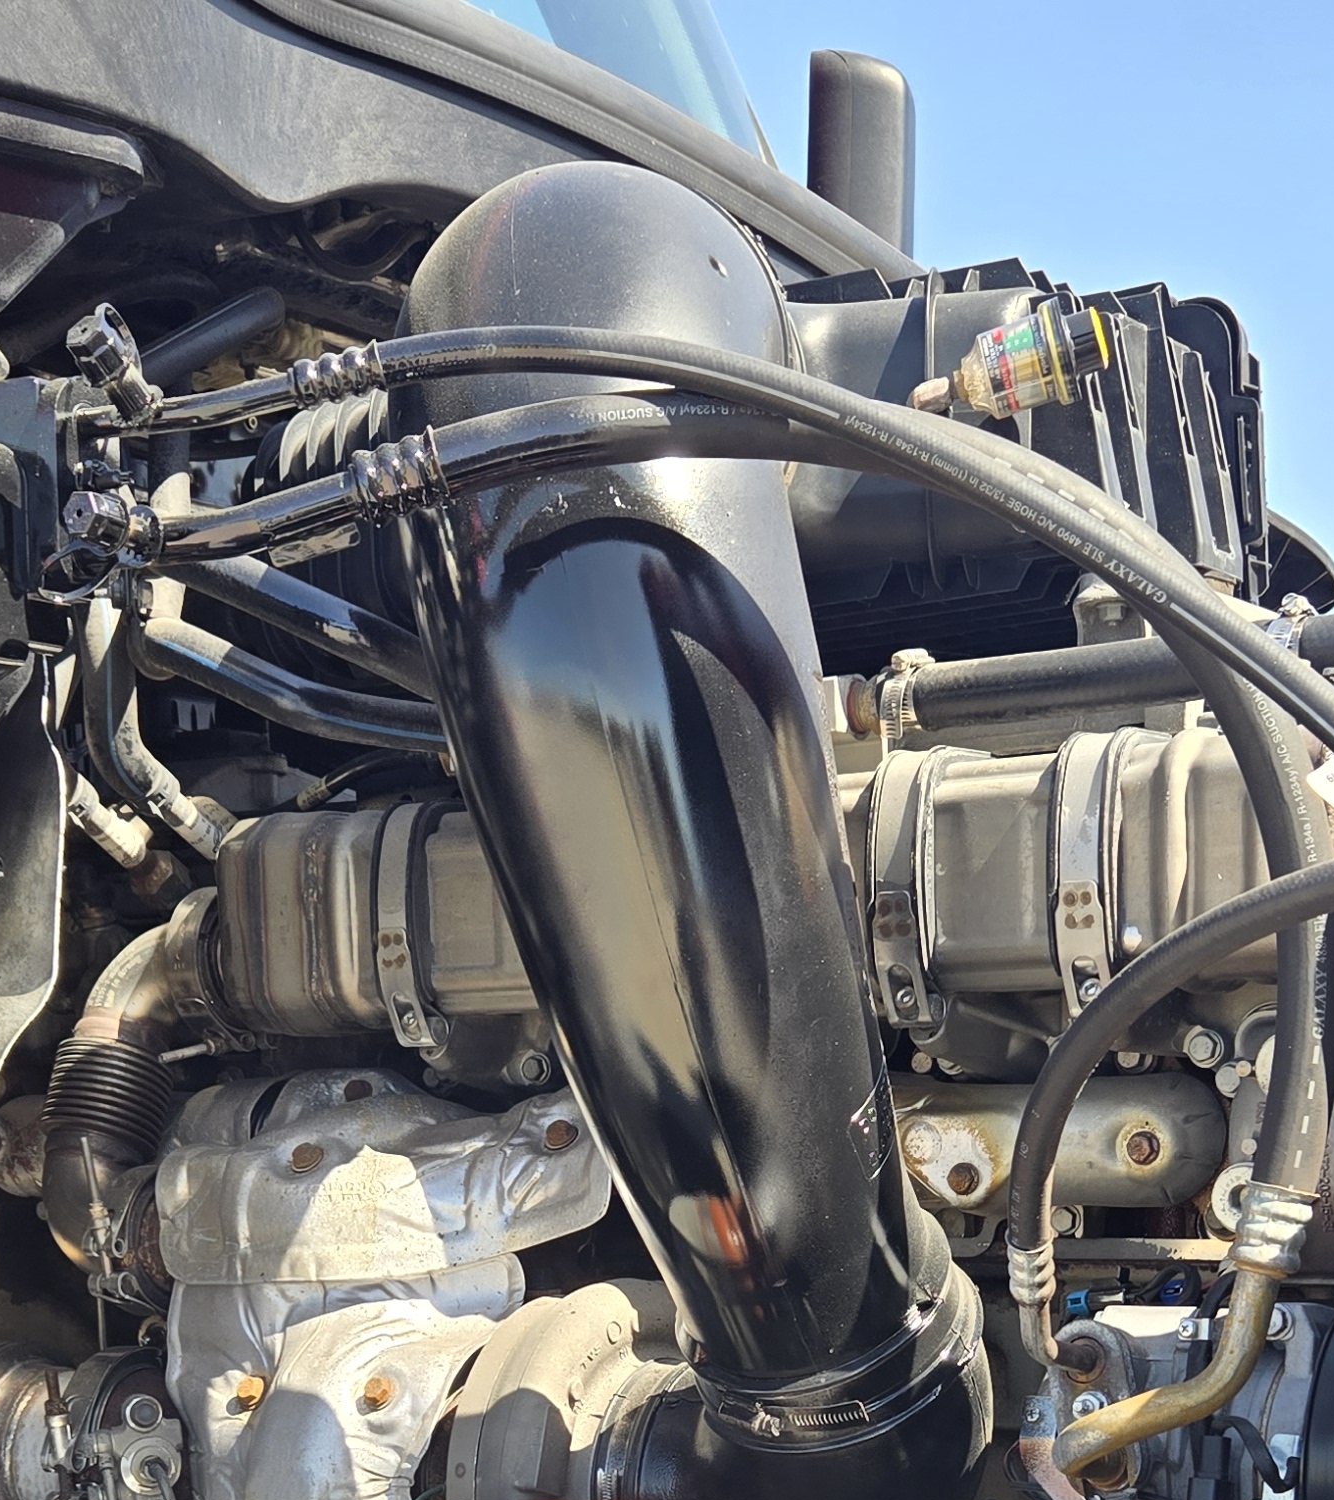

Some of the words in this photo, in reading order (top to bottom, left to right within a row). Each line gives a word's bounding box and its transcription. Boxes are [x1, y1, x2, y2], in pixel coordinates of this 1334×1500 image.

[598, 405, 653, 422] SUCTION
[894, 436, 930, 463] R-134a
[1006, 495, 1038, 523] HOSE
[1037, 513, 1058, 532] A/C
[1057, 526, 1082, 548] 4890
[1083, 540, 1107, 564] SLE
[1103, 557, 1169, 605] GALAXY
[1250, 690, 1283, 743] SUCTION
[1276, 743, 1293, 765] A/C
[1300, 823, 1318, 863] R-134a
[1311, 967, 1328, 1040] GALAXY
